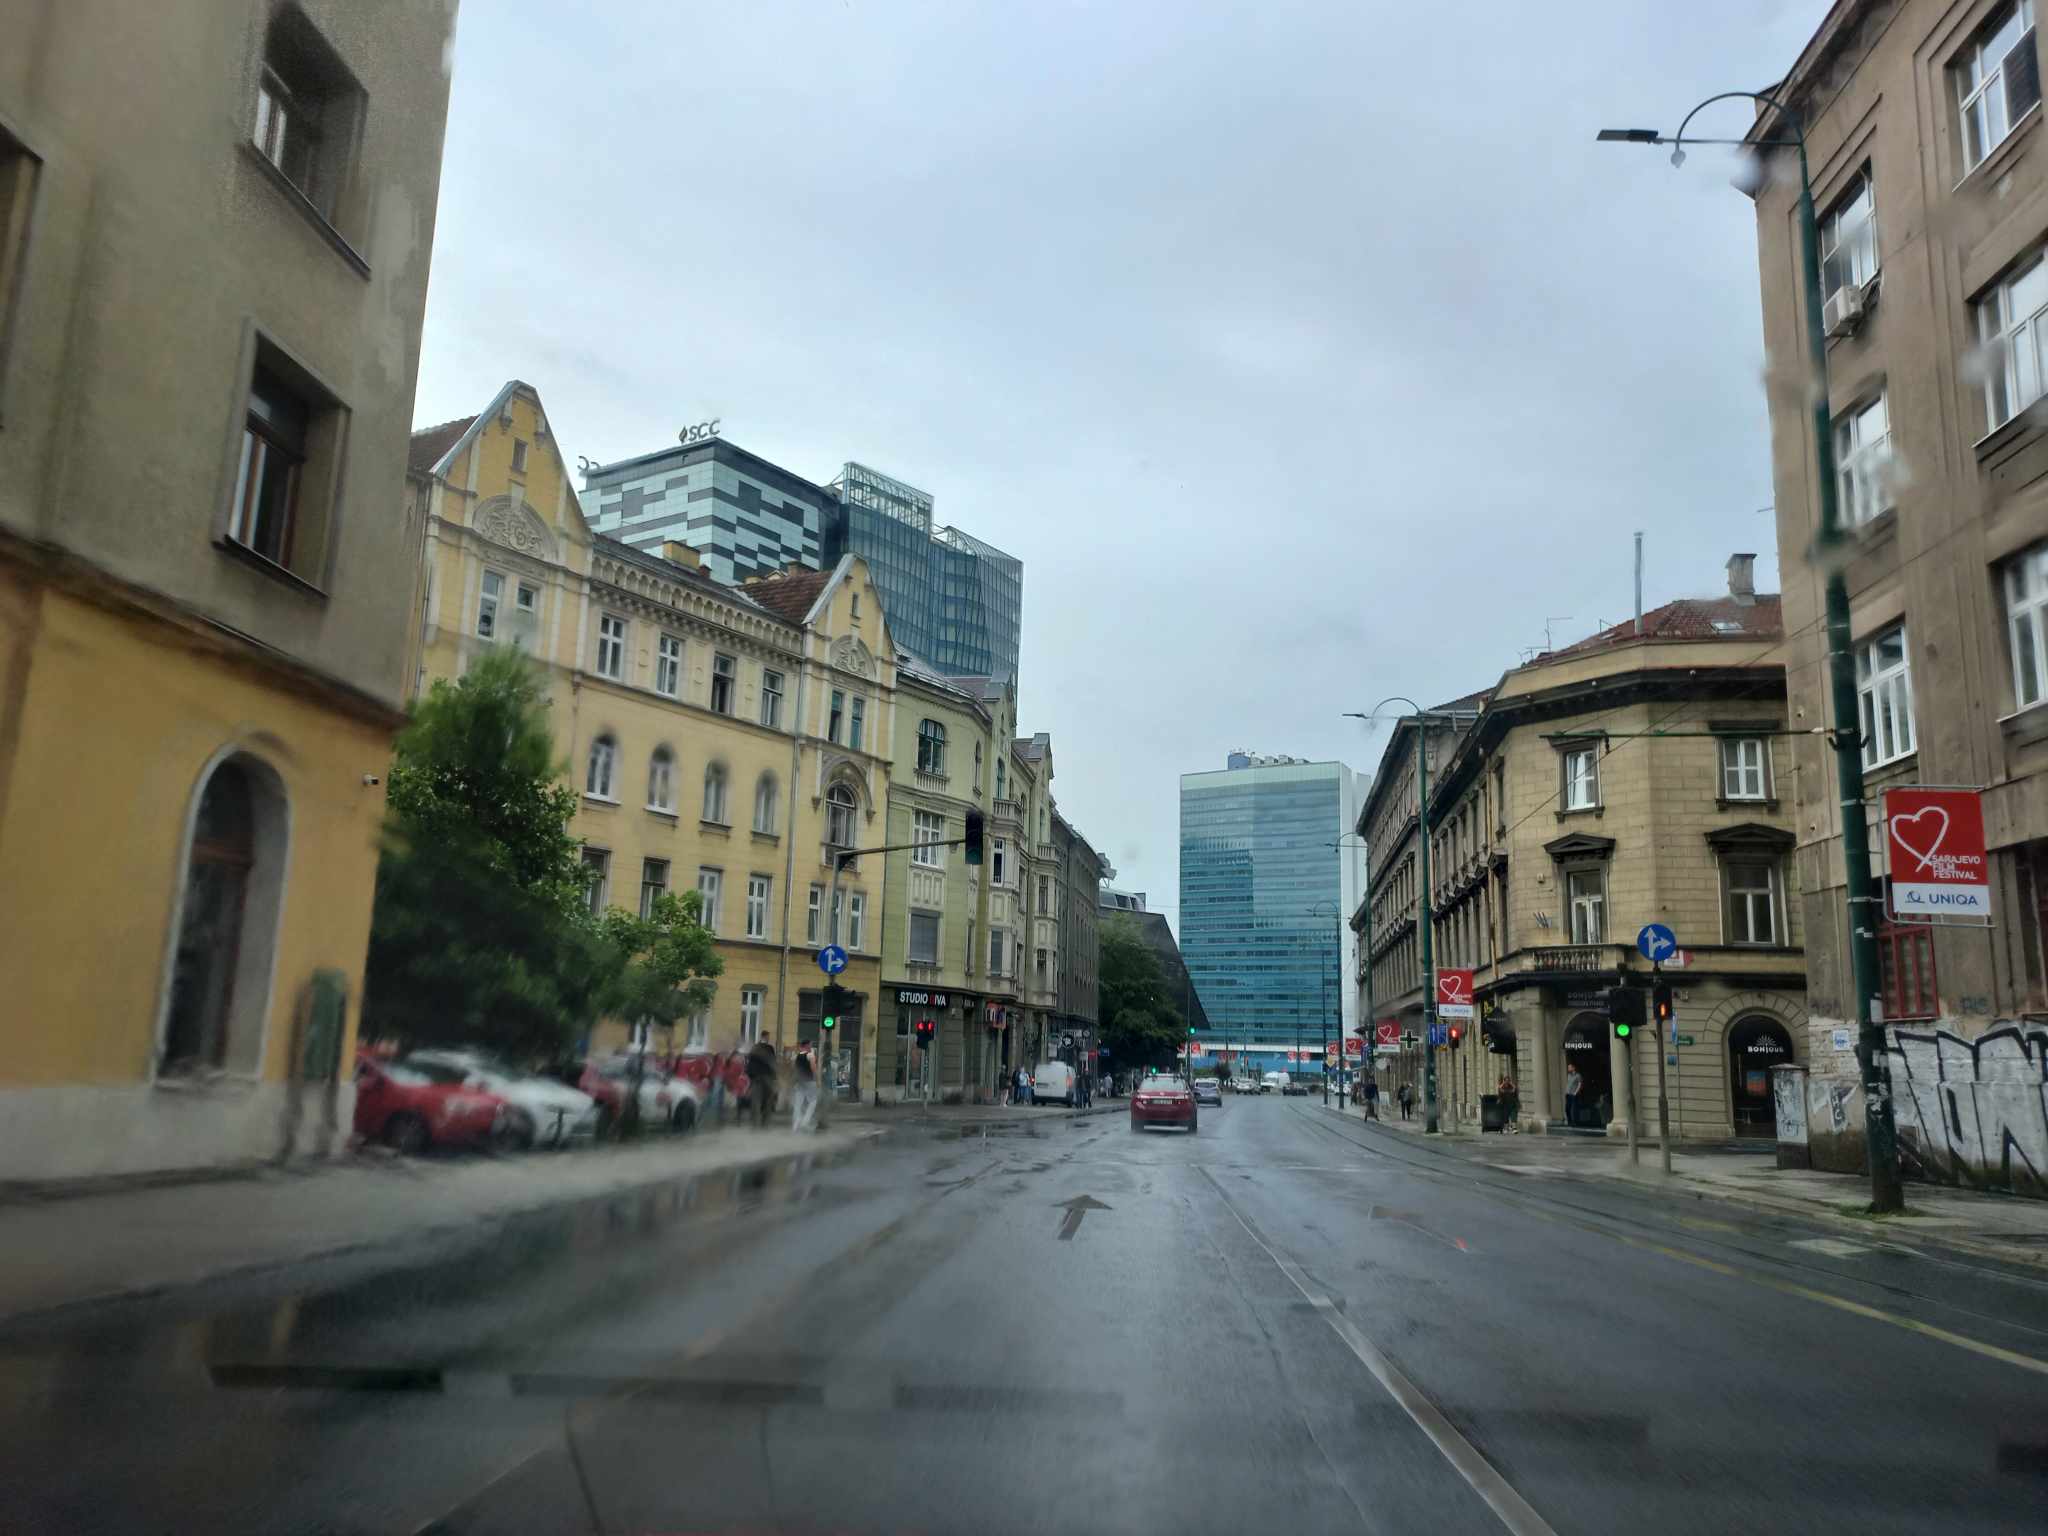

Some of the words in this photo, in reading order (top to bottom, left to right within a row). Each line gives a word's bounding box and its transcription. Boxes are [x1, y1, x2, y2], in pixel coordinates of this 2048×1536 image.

[688, 419, 720, 441] SCC
[1932, 854, 1980, 864] SARAJEVO
[1933, 870, 1977, 880] FESTIVAL
[1929, 893, 1978, 905] UNIQA
[899, 991, 928, 1004] STUDIO
